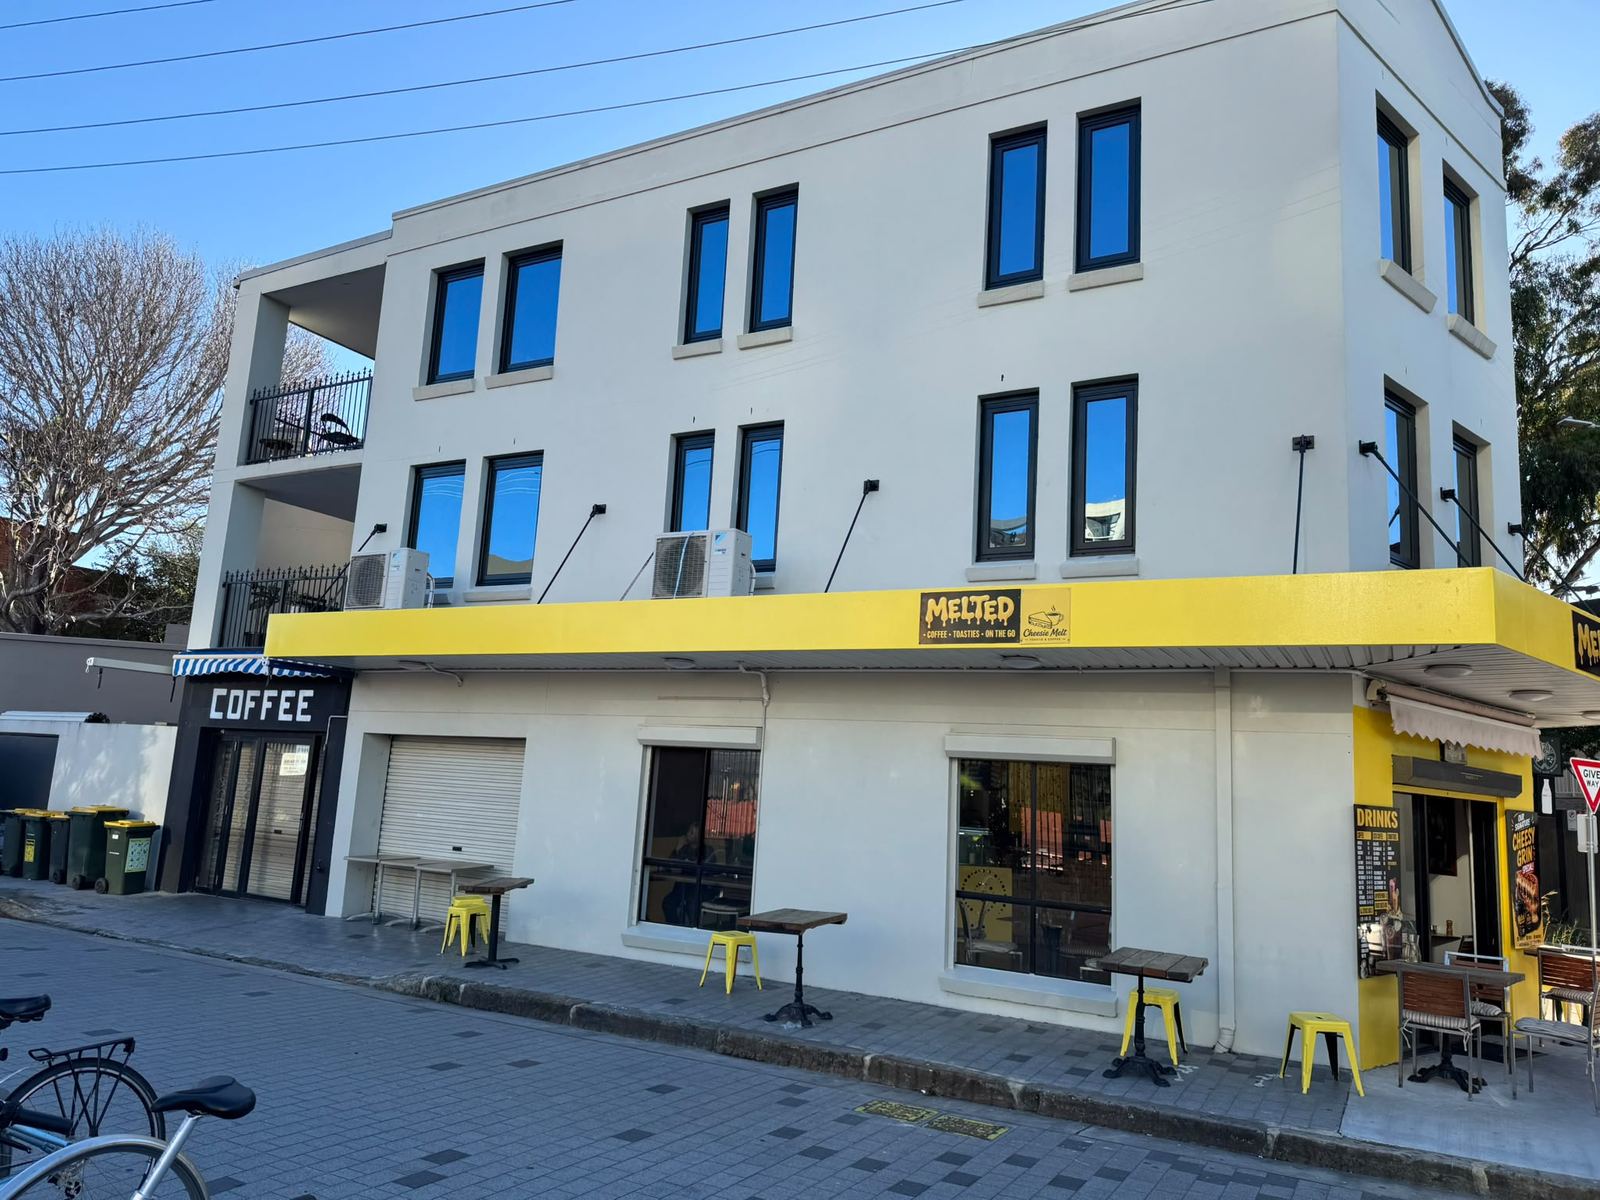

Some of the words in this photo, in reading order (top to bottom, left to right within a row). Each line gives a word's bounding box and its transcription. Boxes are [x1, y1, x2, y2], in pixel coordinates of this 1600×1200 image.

[925, 594, 1015, 629] MELTED
[927, 630, 947, 639] COFFEE
[953, 629, 980, 638] TOASTIES
[985, 629, 994, 638] ON
[995, 629, 1007, 638] THE
[1007, 629, 1016, 637] GO
[1023, 628, 1049, 637] Cheesie
[1050, 628, 1068, 637] Melt
[209, 687, 315, 722] COFFEE
[1583, 768, 1600, 780] GIVE
[1356, 808, 1399, 829] DRINKS
[1512, 826, 1536, 851] CHEESY
